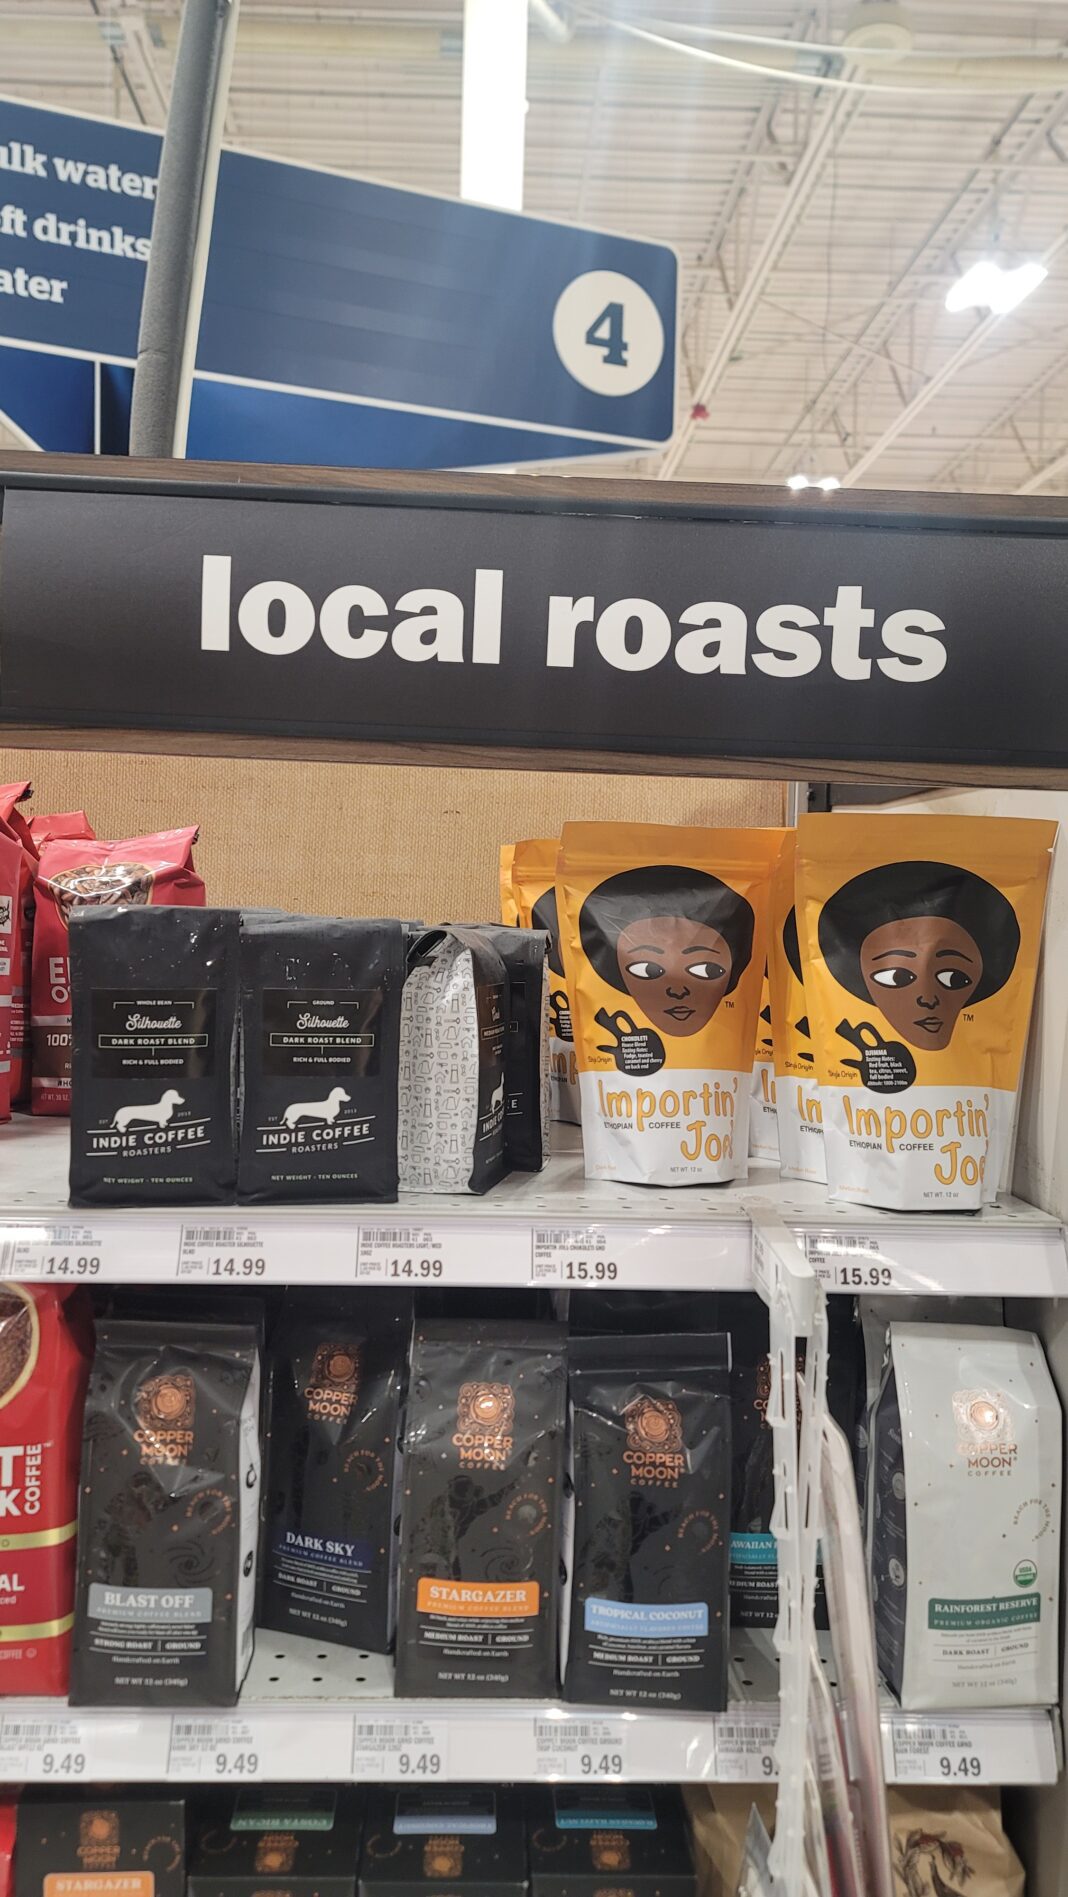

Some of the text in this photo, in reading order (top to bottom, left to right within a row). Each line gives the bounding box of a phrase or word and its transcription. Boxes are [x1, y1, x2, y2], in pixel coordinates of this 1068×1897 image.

[53, 157, 159, 200] water
[0, 204, 152, 262] ft drinks
[0, 267, 68, 303] ater
[585, 302, 629, 367] 4
[201, 554, 948, 682] local roasts
[49, 957, 72, 984] E
[51, 985, 72, 1004] O
[126, 1014, 182, 1031] Silhouette
[297, 1013, 349, 1029] Silhouette
[963, 1014, 974, 1022] TM
[597, 1077, 738, 1132] Importin'
[649, 1122, 681, 1130] COFFEE
[843, 1093, 990, 1153] Importin'
[93, 1126, 205, 1148] INDIE COFFEE
[263, 1124, 369, 1145] INDIE COFFEE
[122, 1146, 172, 1157] ROASTERS
[292, 1142, 338, 1153] ROASTERS
[849, 1140, 934, 1151] ETHIOPIAN COFFEE
[46, 1256, 100, 1275] 14.99
[212, 1258, 266, 1276] 14.99
[391, 1259, 444, 1278] 14.99
[566, 1262, 618, 1280] 15.99
[840, 1267, 892, 1286] 15.99
[304, 1387, 358, 1405] COPPER
[308, 1400, 350, 1416] MOON
[133, 1430, 194, 1443] COPPER
[452, 1434, 513, 1449] COPPER
[140, 1445, 188, 1456] MOON
[459, 1448, 506, 1461] MOON
[623, 1451, 684, 1466] COPPER
[459, 1462, 506, 1471] COFFEE
[968, 1457, 1012, 1468] MOON
[24, 1443, 42, 1515] COFFEE
[631, 1466, 679, 1479] MOON
[630, 1479, 678, 1488] COFFEE
[286, 1531, 355, 1556] DARK SKY
[731, 1541, 772, 1549] AWAIIAN
[0, 1573, 25, 1592] AL
[331, 1585, 361, 1596] GROUND
[104, 1592, 194, 1608] BLAST OFF
[430, 1586, 526, 1602] STARGAZER
[591, 1605, 704, 1621] TROPICAL COCONUT
[934, 1598, 1038, 1614] RAINFOREST RESERVE
[975, 1617, 1009, 1625] ORGANIC
[94, 1638, 124, 1649] STRONG
[126, 1641, 153, 1649] ROAST
[424, 1631, 457, 1640] MEDIUM
[457, 1634, 483, 1642] ROAST
[1001, 1642, 1029, 1652] GROUND
[593, 1651, 700, 1663] MEDIUM ROAST GROUND
[609, 1689, 623, 1697] NET
[42, 1753, 86, 1774] 9.49
[216, 1753, 258, 1774] 9.49
[399, 1754, 440, 1774] 9.49
[581, 1754, 622, 1774] 9.49
[762, 1756, 779, 1776] 9.
[940, 1756, 981, 1776] 9.49
[56, 1878, 142, 1892] STARGAZER
